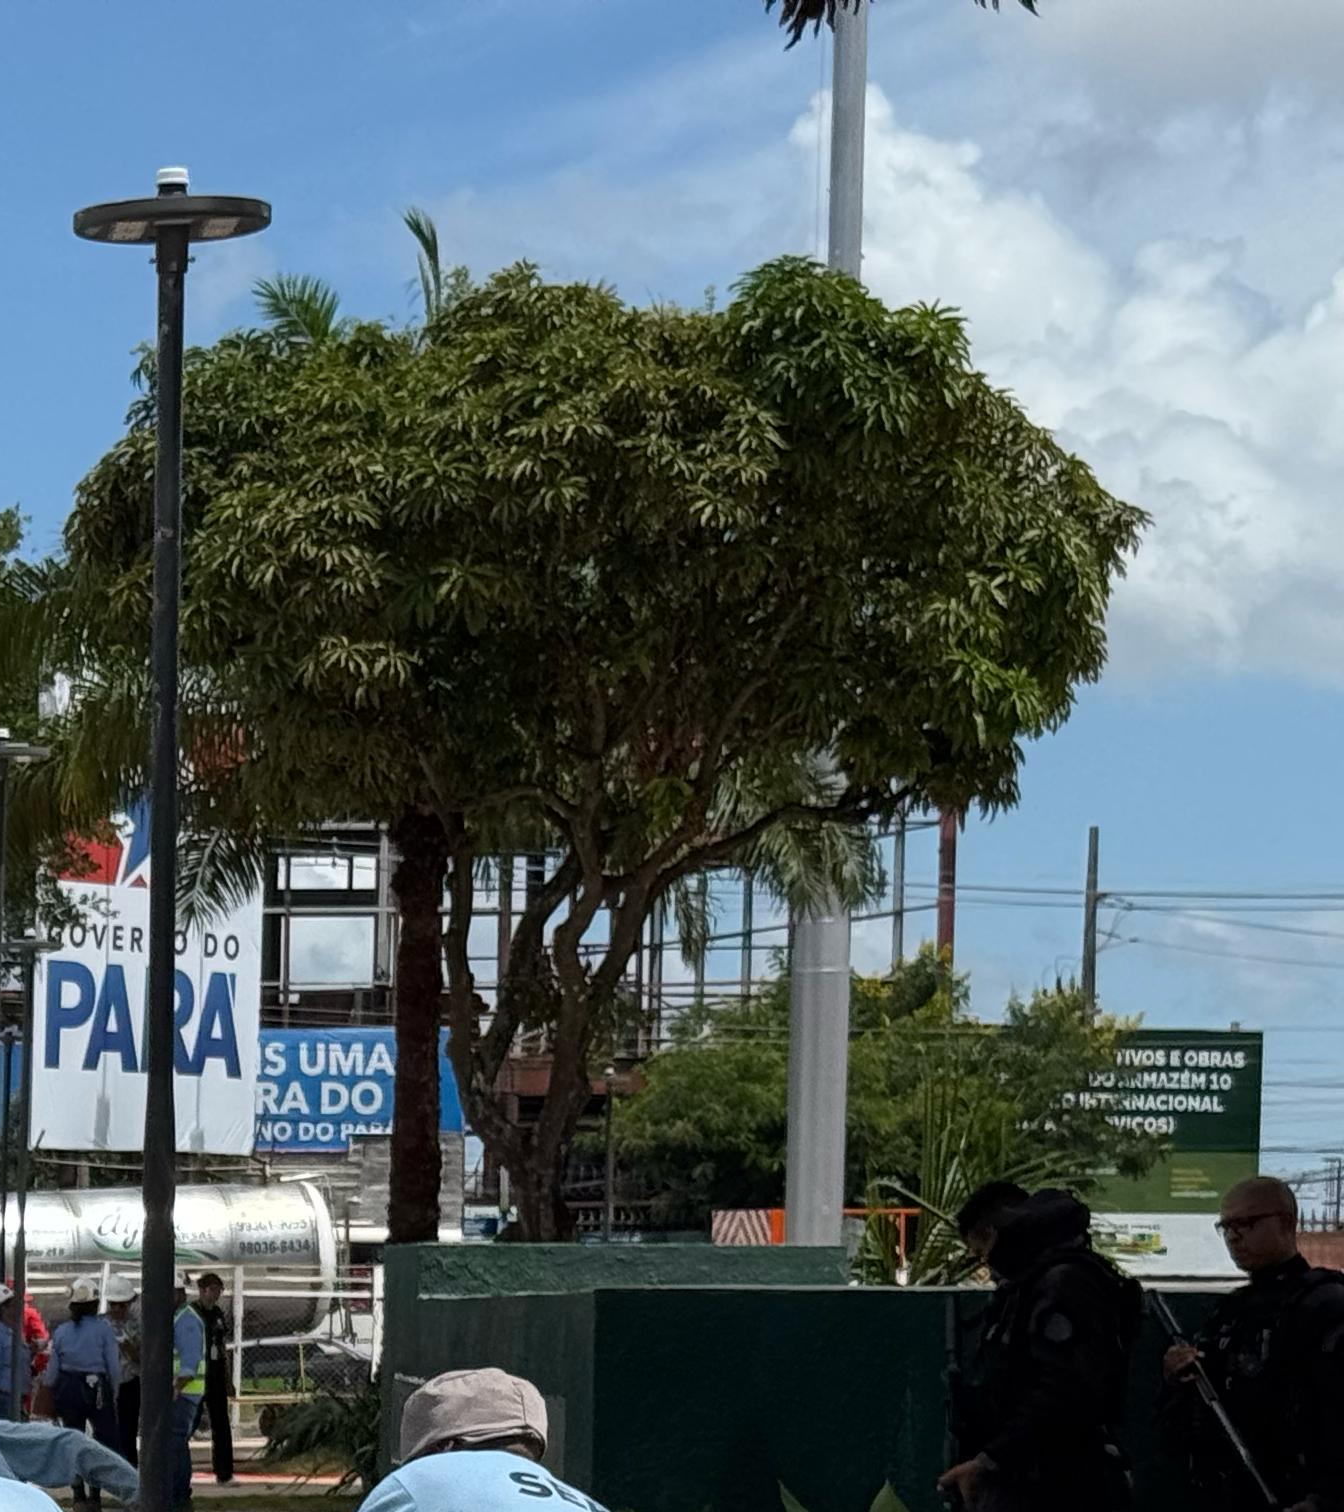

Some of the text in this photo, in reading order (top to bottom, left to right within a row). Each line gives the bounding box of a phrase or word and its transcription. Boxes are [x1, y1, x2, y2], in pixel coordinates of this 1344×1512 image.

[48, 923, 240, 961] GOVERO DO
[299, 1042, 396, 1077] UMA
[1184, 1050, 1247, 1069] OBRAS
[1209, 1073, 1232, 1091] 10
[320, 1080, 383, 1115] DO
[298, 1122, 334, 1142] DO
